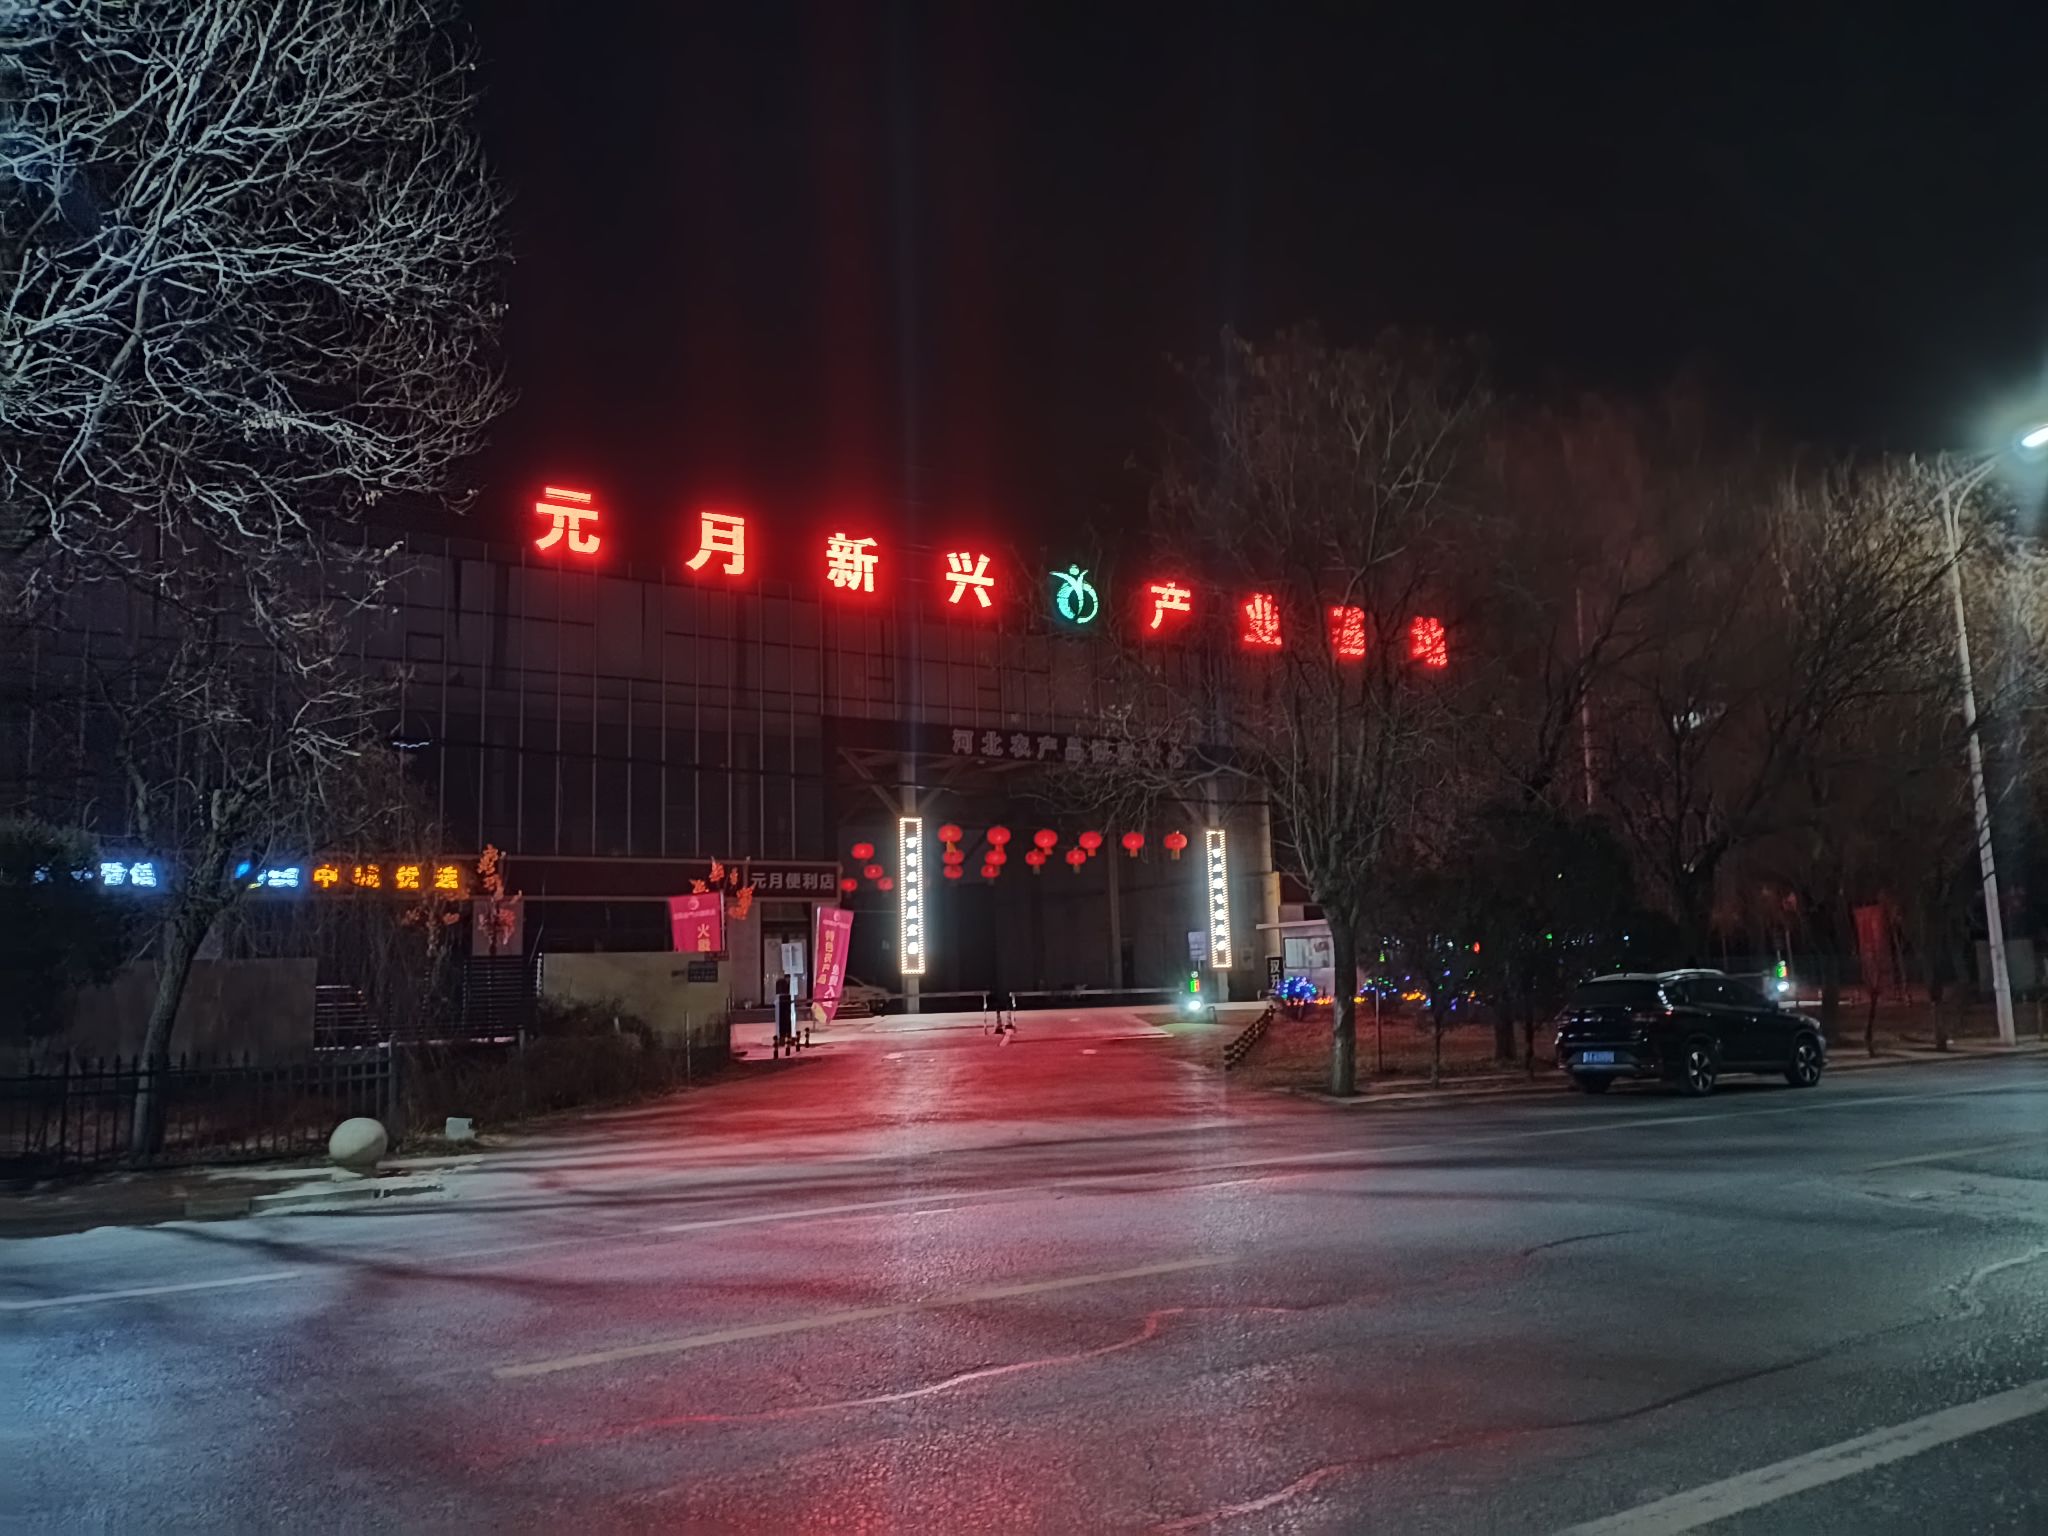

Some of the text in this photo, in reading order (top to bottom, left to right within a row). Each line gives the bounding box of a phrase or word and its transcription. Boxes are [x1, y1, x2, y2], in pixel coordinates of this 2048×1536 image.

[535, 486, 995, 608] 元月新兴
[751, 872, 835, 890] 元月便利店
